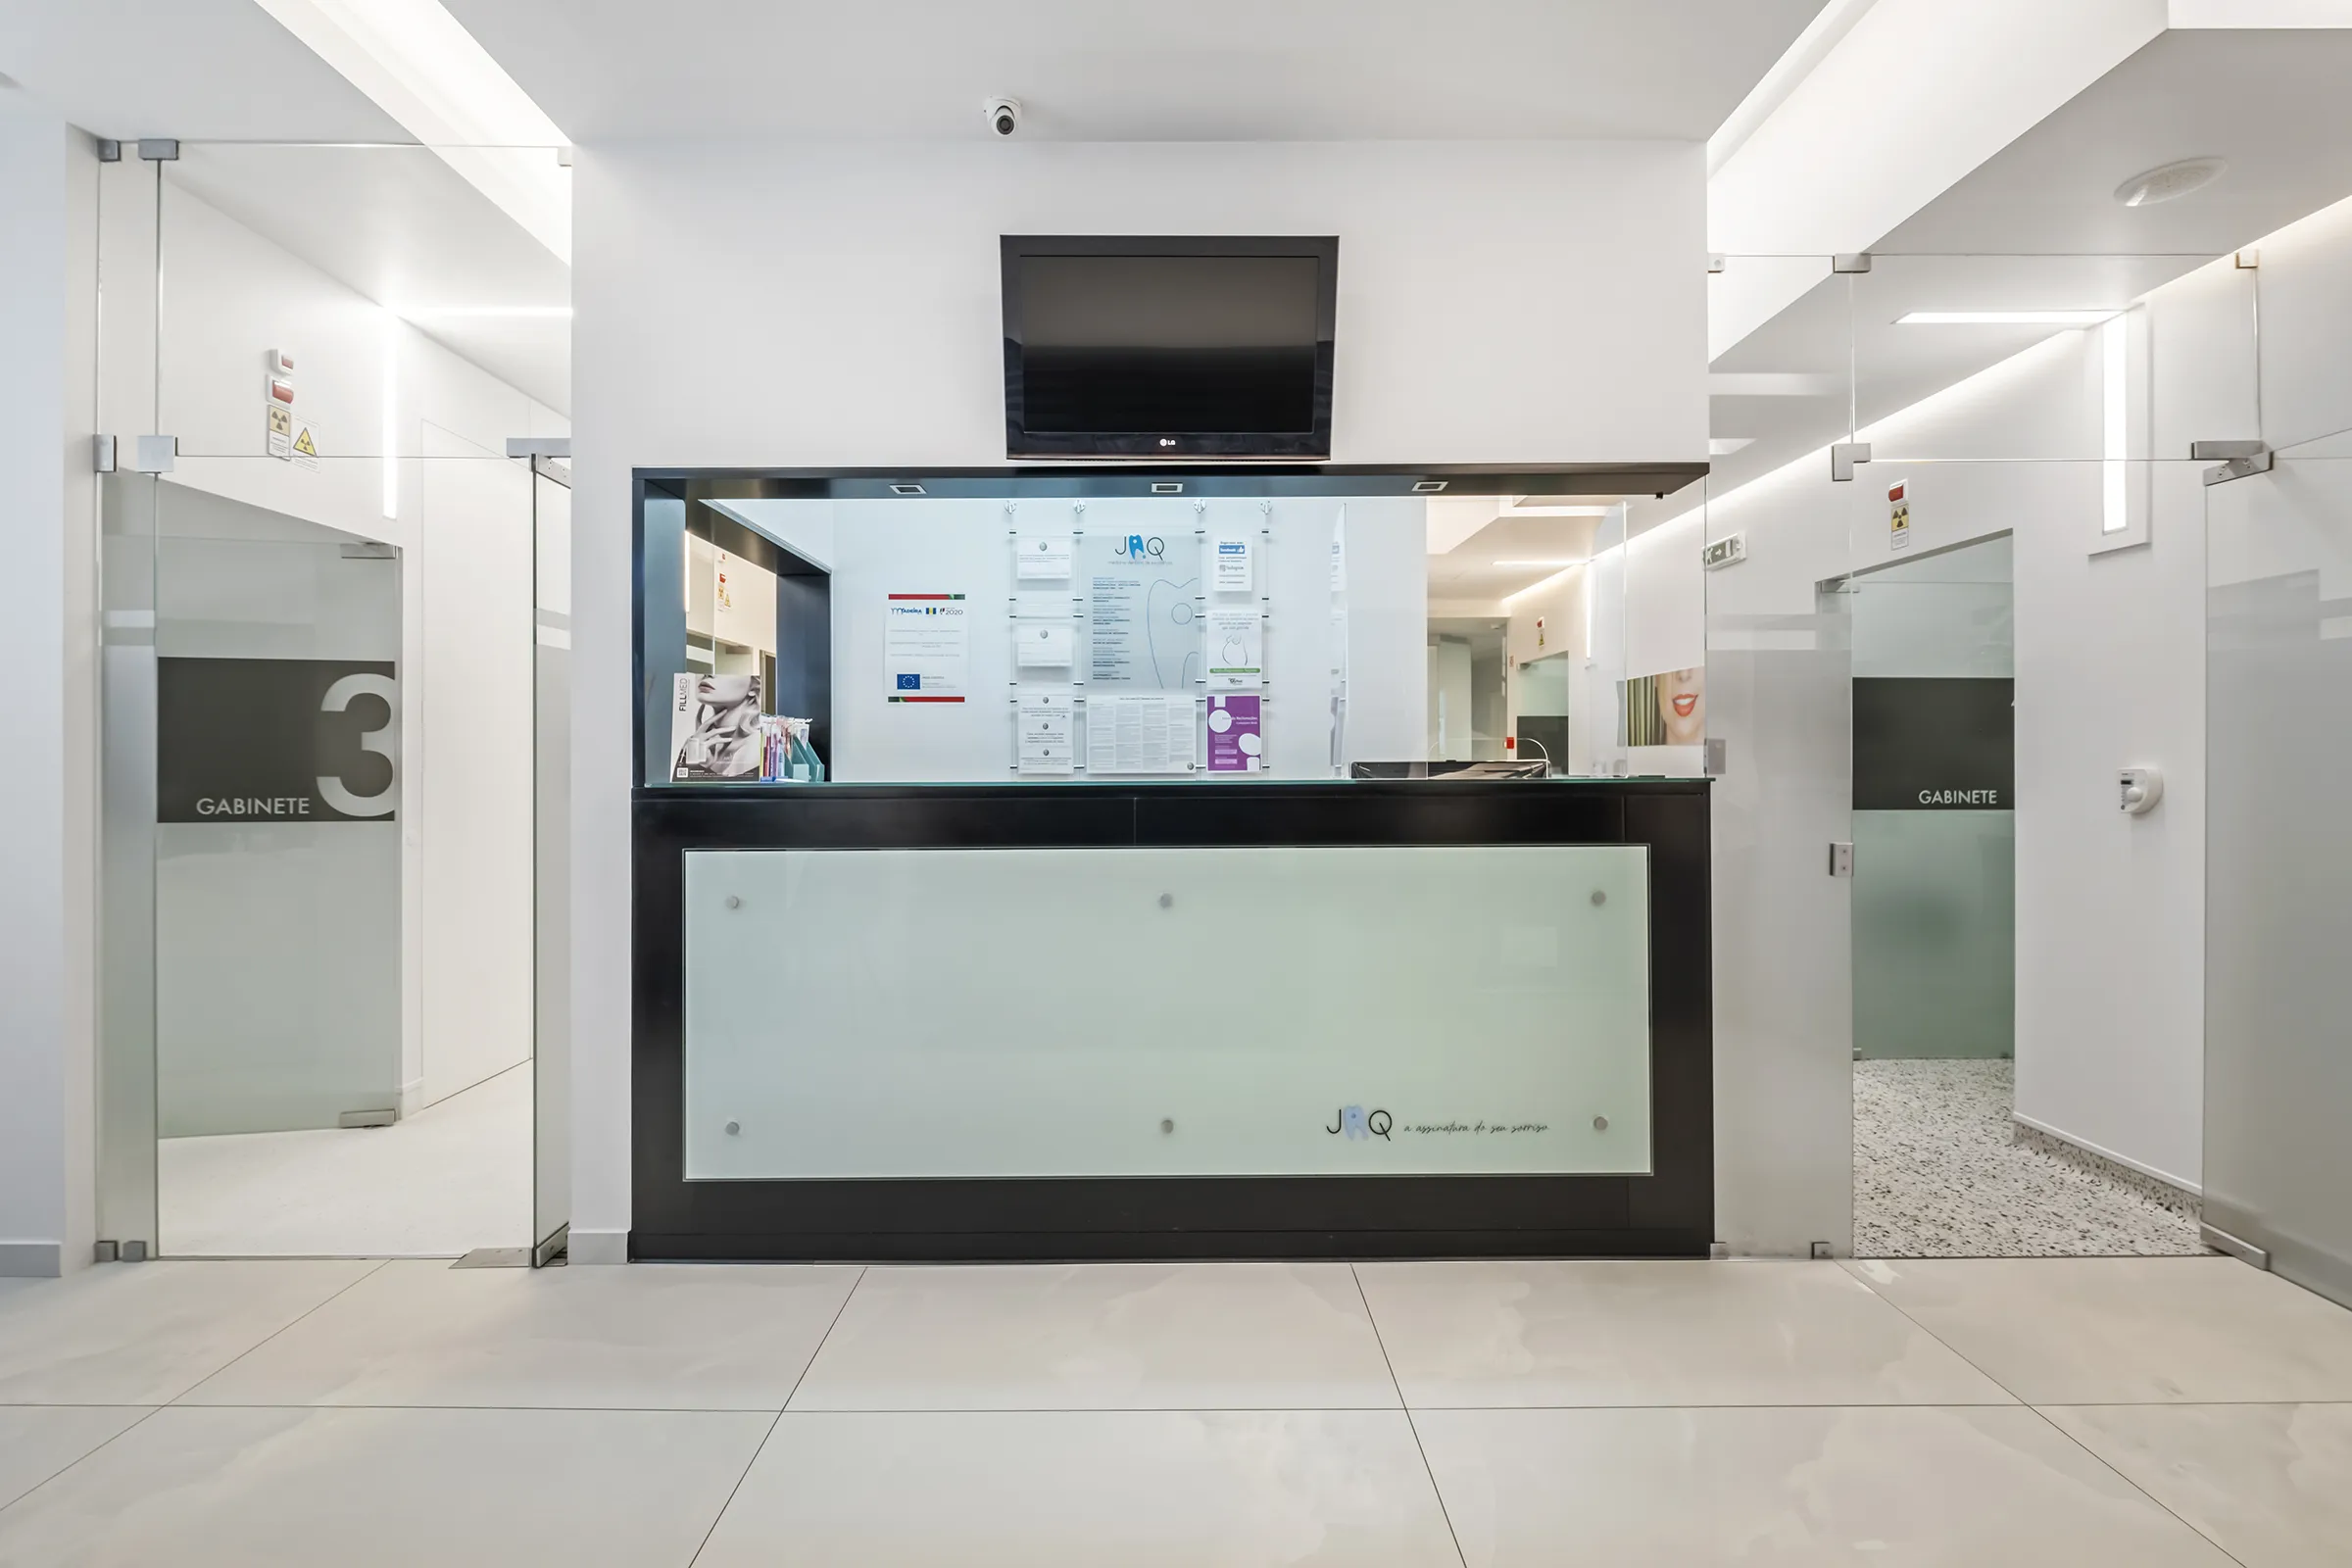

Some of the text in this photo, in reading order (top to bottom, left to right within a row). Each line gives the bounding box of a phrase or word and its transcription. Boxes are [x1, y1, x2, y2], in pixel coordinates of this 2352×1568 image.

[678, 678, 688, 712] FILLMED
[196, 672, 395, 817] GABINETE 3
[1918, 789, 1997, 805] GABINETE
[1415, 1120, 1470, 1135] assinatura
[1490, 1125, 1507, 1134] seu
[1510, 1124, 1549, 1134] sorriso
